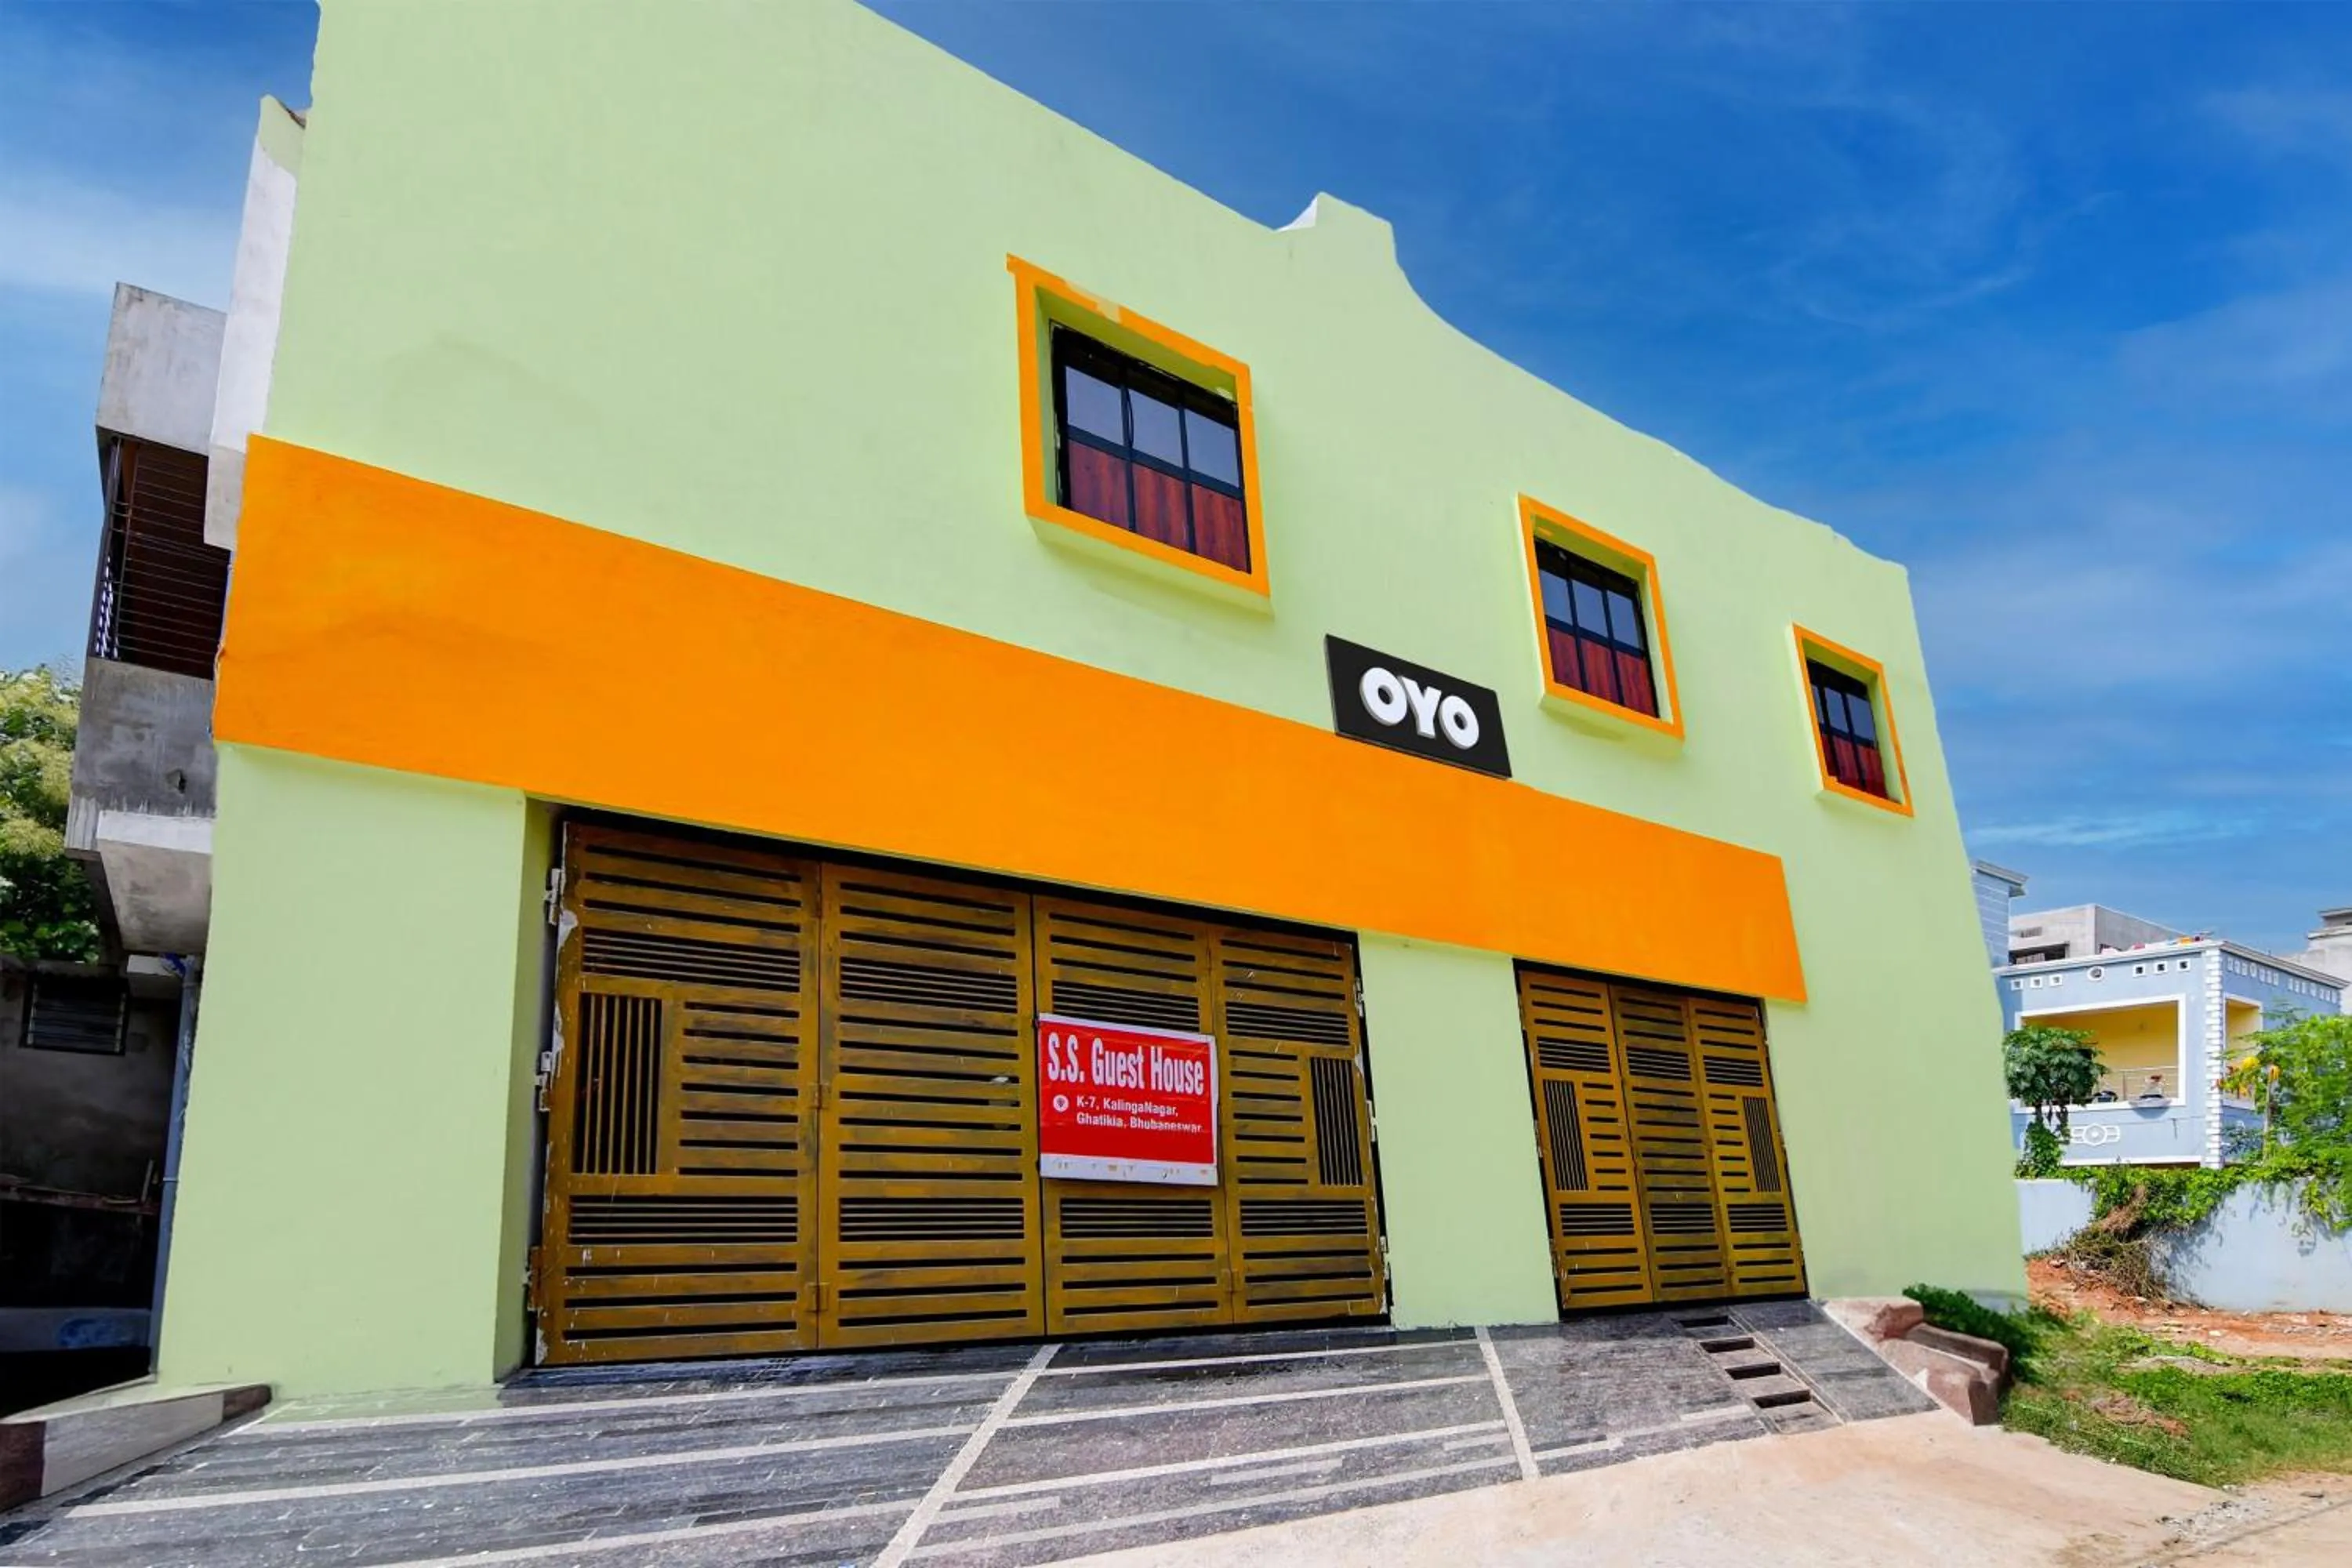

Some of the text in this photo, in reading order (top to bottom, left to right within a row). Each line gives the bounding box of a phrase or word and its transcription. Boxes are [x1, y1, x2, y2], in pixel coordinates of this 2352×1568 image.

[1359, 666, 1479, 750] OYO
[1047, 1032, 1204, 1095] S.S. Guest House
